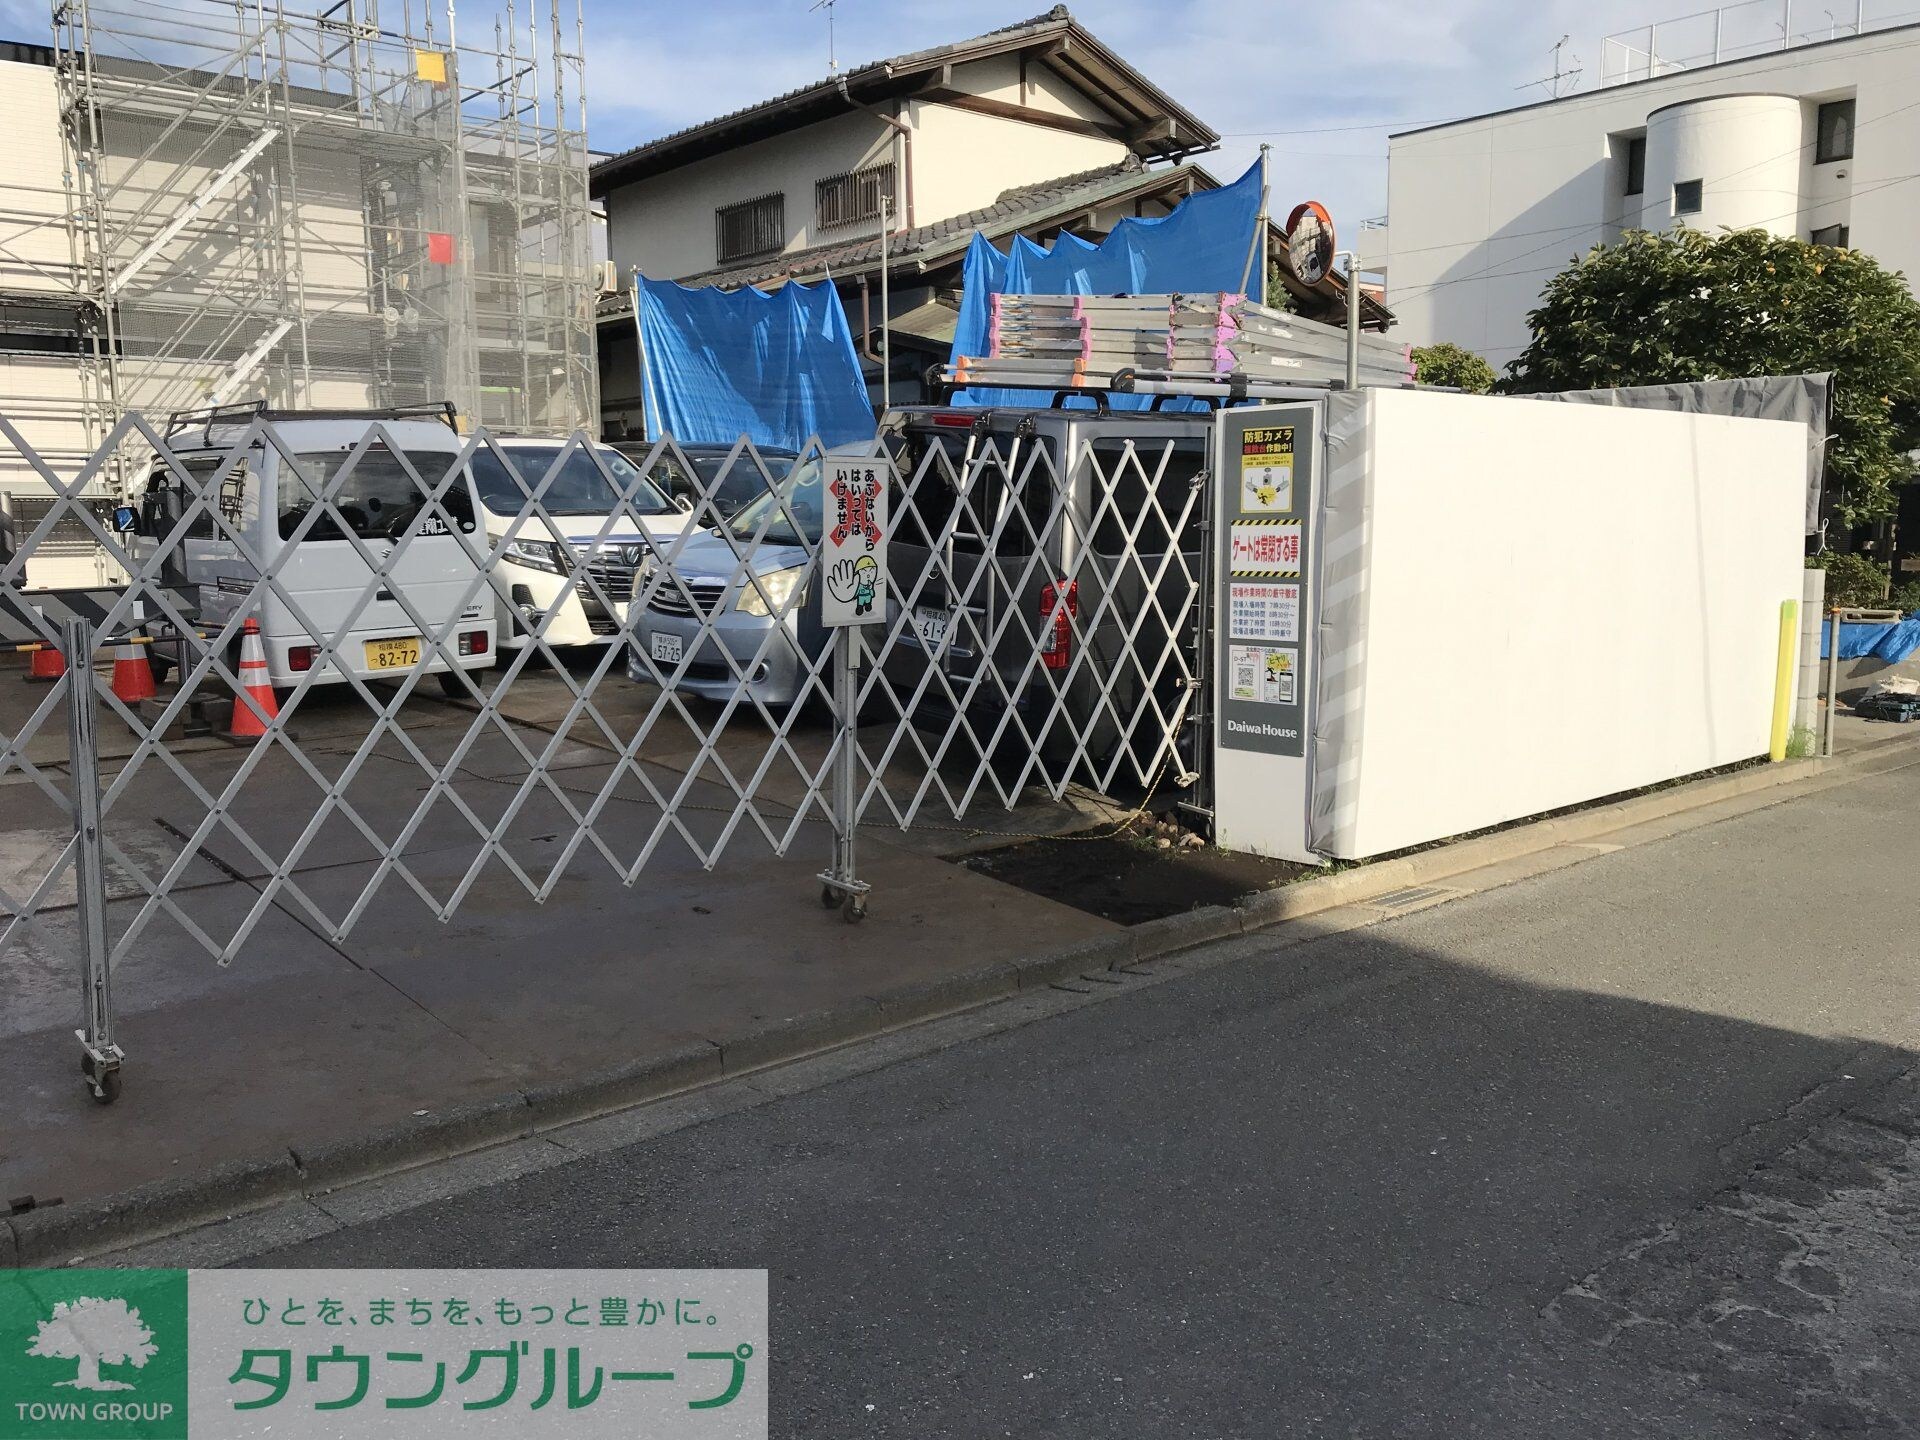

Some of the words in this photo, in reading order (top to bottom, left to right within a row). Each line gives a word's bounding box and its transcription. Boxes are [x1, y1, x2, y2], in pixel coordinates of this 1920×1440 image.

[1244, 429, 1293, 443] 防犯カメラ
[837, 469, 847, 539] いけません
[851, 469, 861, 536] はいっては
[864, 469, 875, 551] あぶないから
[1232, 535, 1299, 564] ゲートは常閉する事
[379, 650, 418, 667] 82-72
[657, 645, 681, 662] 57-25
[1227, 719, 1262, 735] Daiwa
[1262, 723, 1298, 738] House
